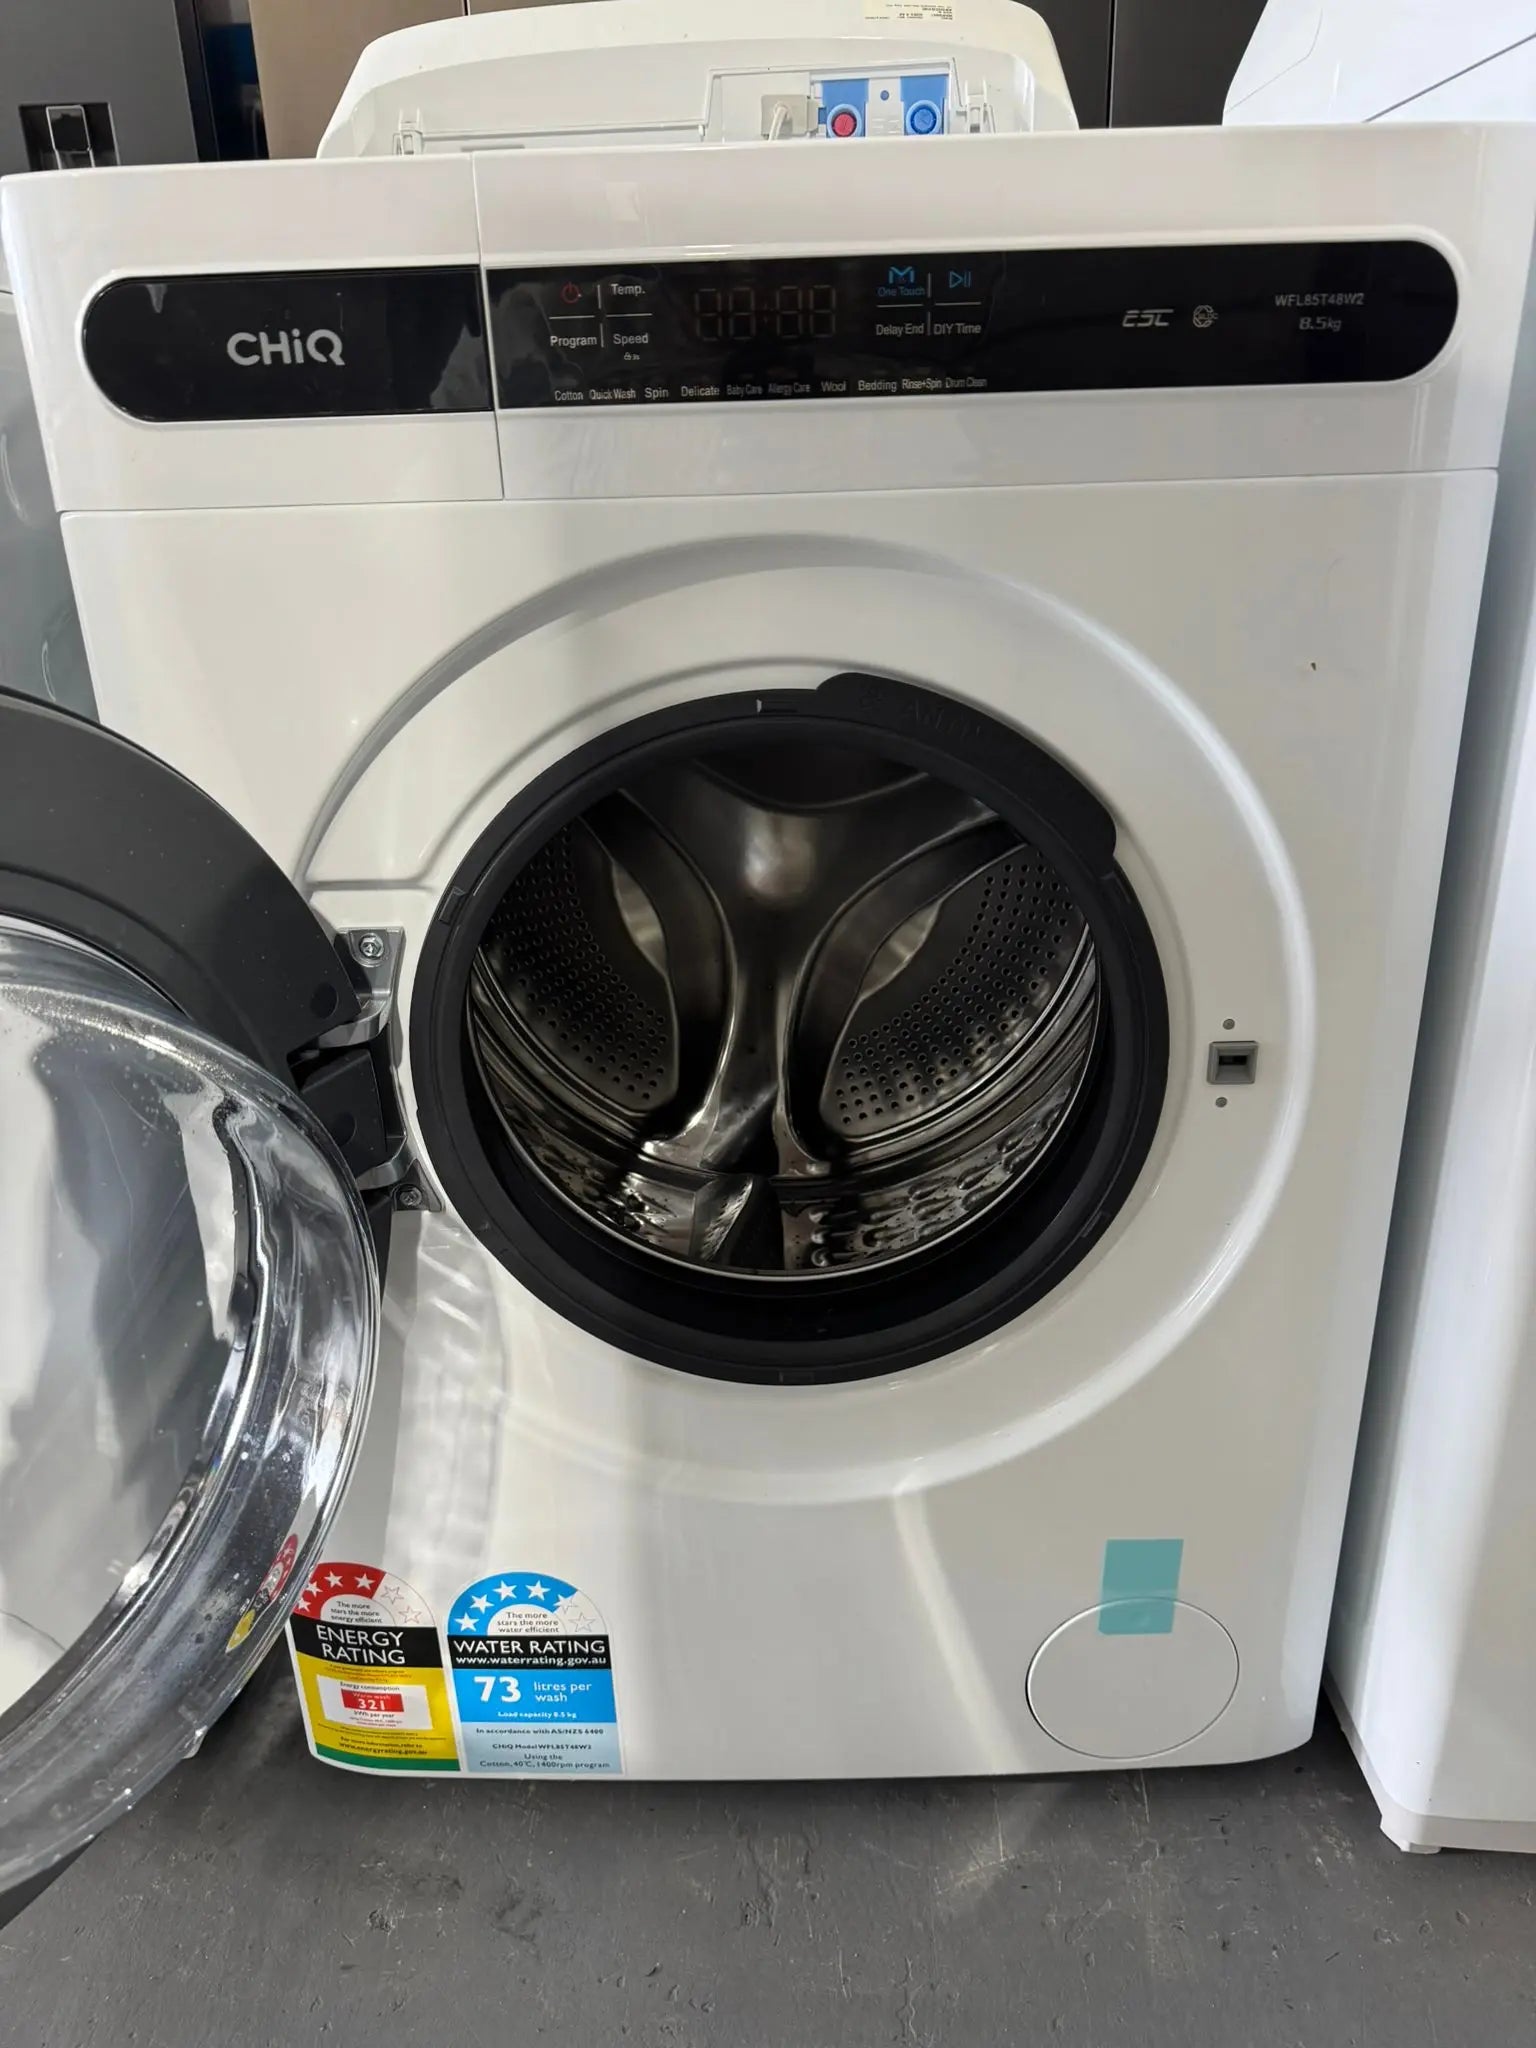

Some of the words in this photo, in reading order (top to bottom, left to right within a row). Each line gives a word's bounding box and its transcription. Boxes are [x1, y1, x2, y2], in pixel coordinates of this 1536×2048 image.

[610, 283, 646, 296] Temp.
[899, 286, 925, 297] Touch
[1275, 293, 1365, 306] WFL85T48W2
[933, 322, 954, 335] DIY
[954, 321, 982, 334] Time
[1299, 316, 1342, 331] 8.5kg
[876, 324, 904, 339] Delay
[904, 323, 925, 335] End
[226, 327, 346, 366] CHiQ
[549, 335, 598, 349] Program
[612, 333, 649, 347] Speed
[680, 384, 721, 398] Delicate
[821, 380, 847, 393] Wool
[857, 379, 897, 393] Bedding
[554, 390, 584, 401] Cotton
[588, 389, 613, 400] Quick
[612, 388, 637, 400] Wash
[644, 386, 670, 400] Spin
[330, 1607, 348, 1616] stars
[347, 1608, 360, 1616] the
[336, 1600, 351, 1608] The
[351, 1602, 370, 1610] more
[507, 1611, 523, 1620] The
[316, 1624, 404, 1647] ENERGY
[453, 1640, 524, 1654] WATER
[529, 1640, 605, 1654] RATING
[321, 1643, 406, 1665] RATING
[455, 1655, 607, 1667] www.waterrating.gov.au
[473, 1675, 522, 1703] 73
[533, 1681, 567, 1691] litres
[570, 1683, 592, 1694] per
[535, 1692, 568, 1703] wash
[358, 1698, 386, 1711] 321
[524, 1753, 548, 1761] Using
